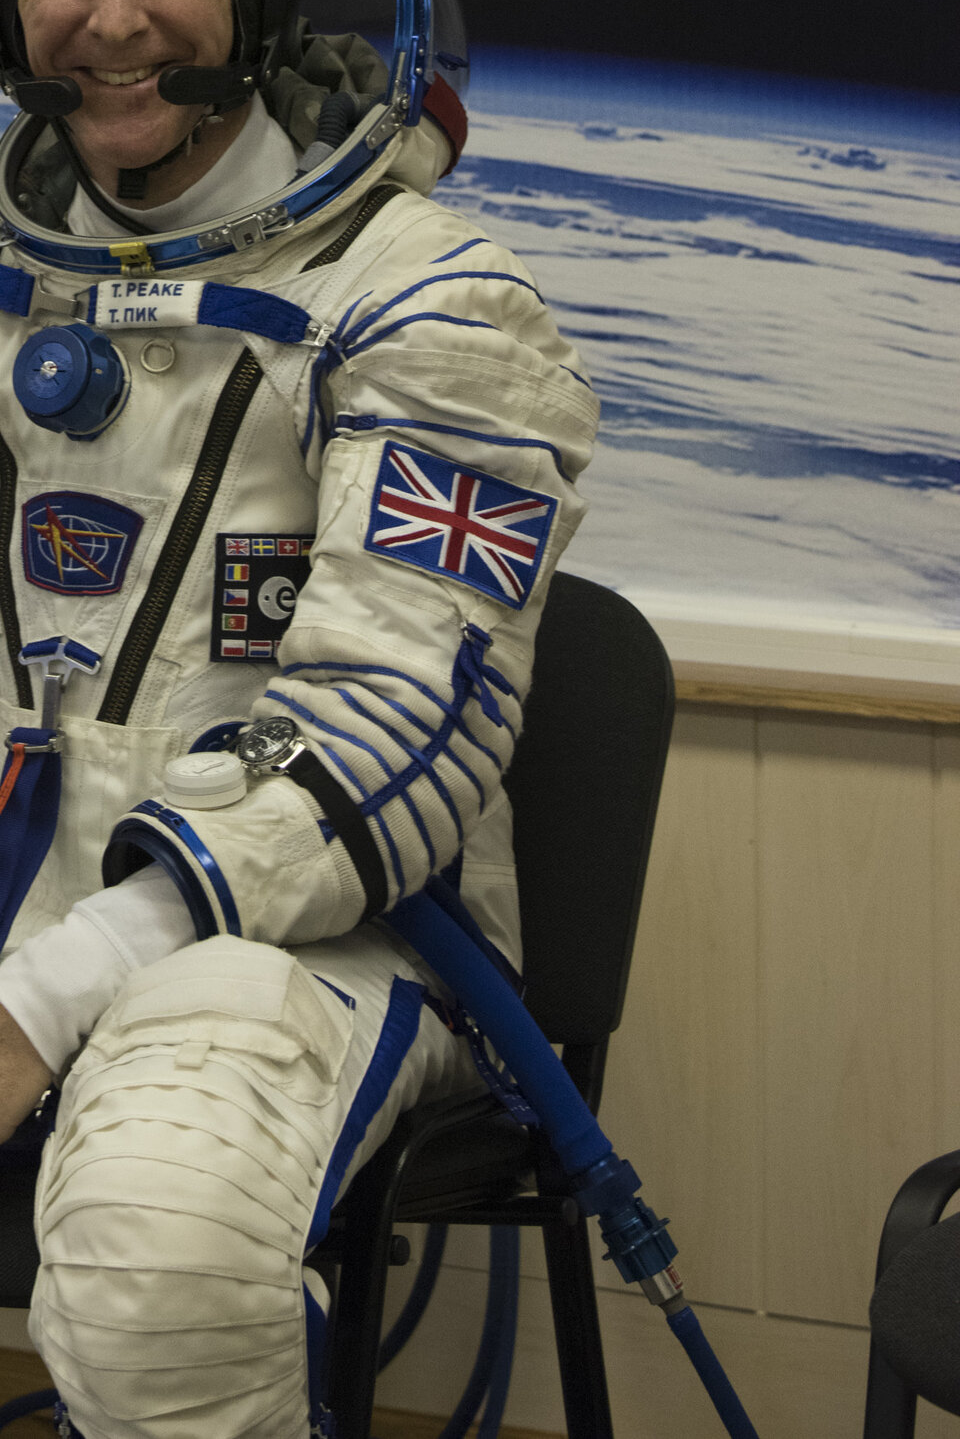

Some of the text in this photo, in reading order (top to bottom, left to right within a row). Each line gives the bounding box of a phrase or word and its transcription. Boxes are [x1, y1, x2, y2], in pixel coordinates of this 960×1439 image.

[112, 283, 184, 298] T. PEAKE
[108, 307, 157, 323] Т. ПИК
